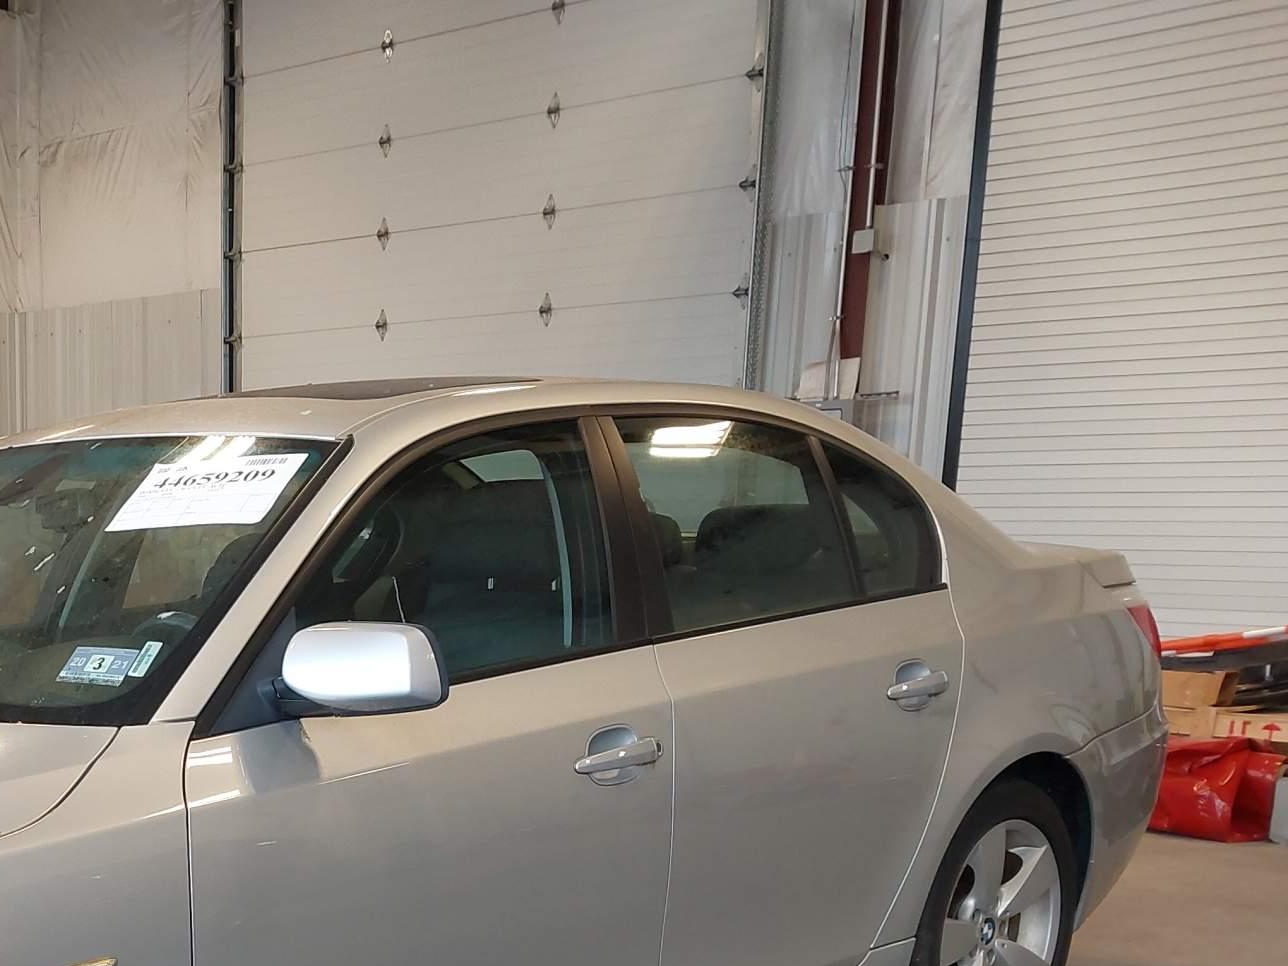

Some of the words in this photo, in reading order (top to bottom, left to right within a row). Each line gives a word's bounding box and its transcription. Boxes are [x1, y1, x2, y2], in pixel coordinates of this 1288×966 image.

[153, 468, 276, 489] 44659209
[69, 657, 86, 667] 20
[92, 656, 105, 670] 3
[111, 660, 128, 669] 21
